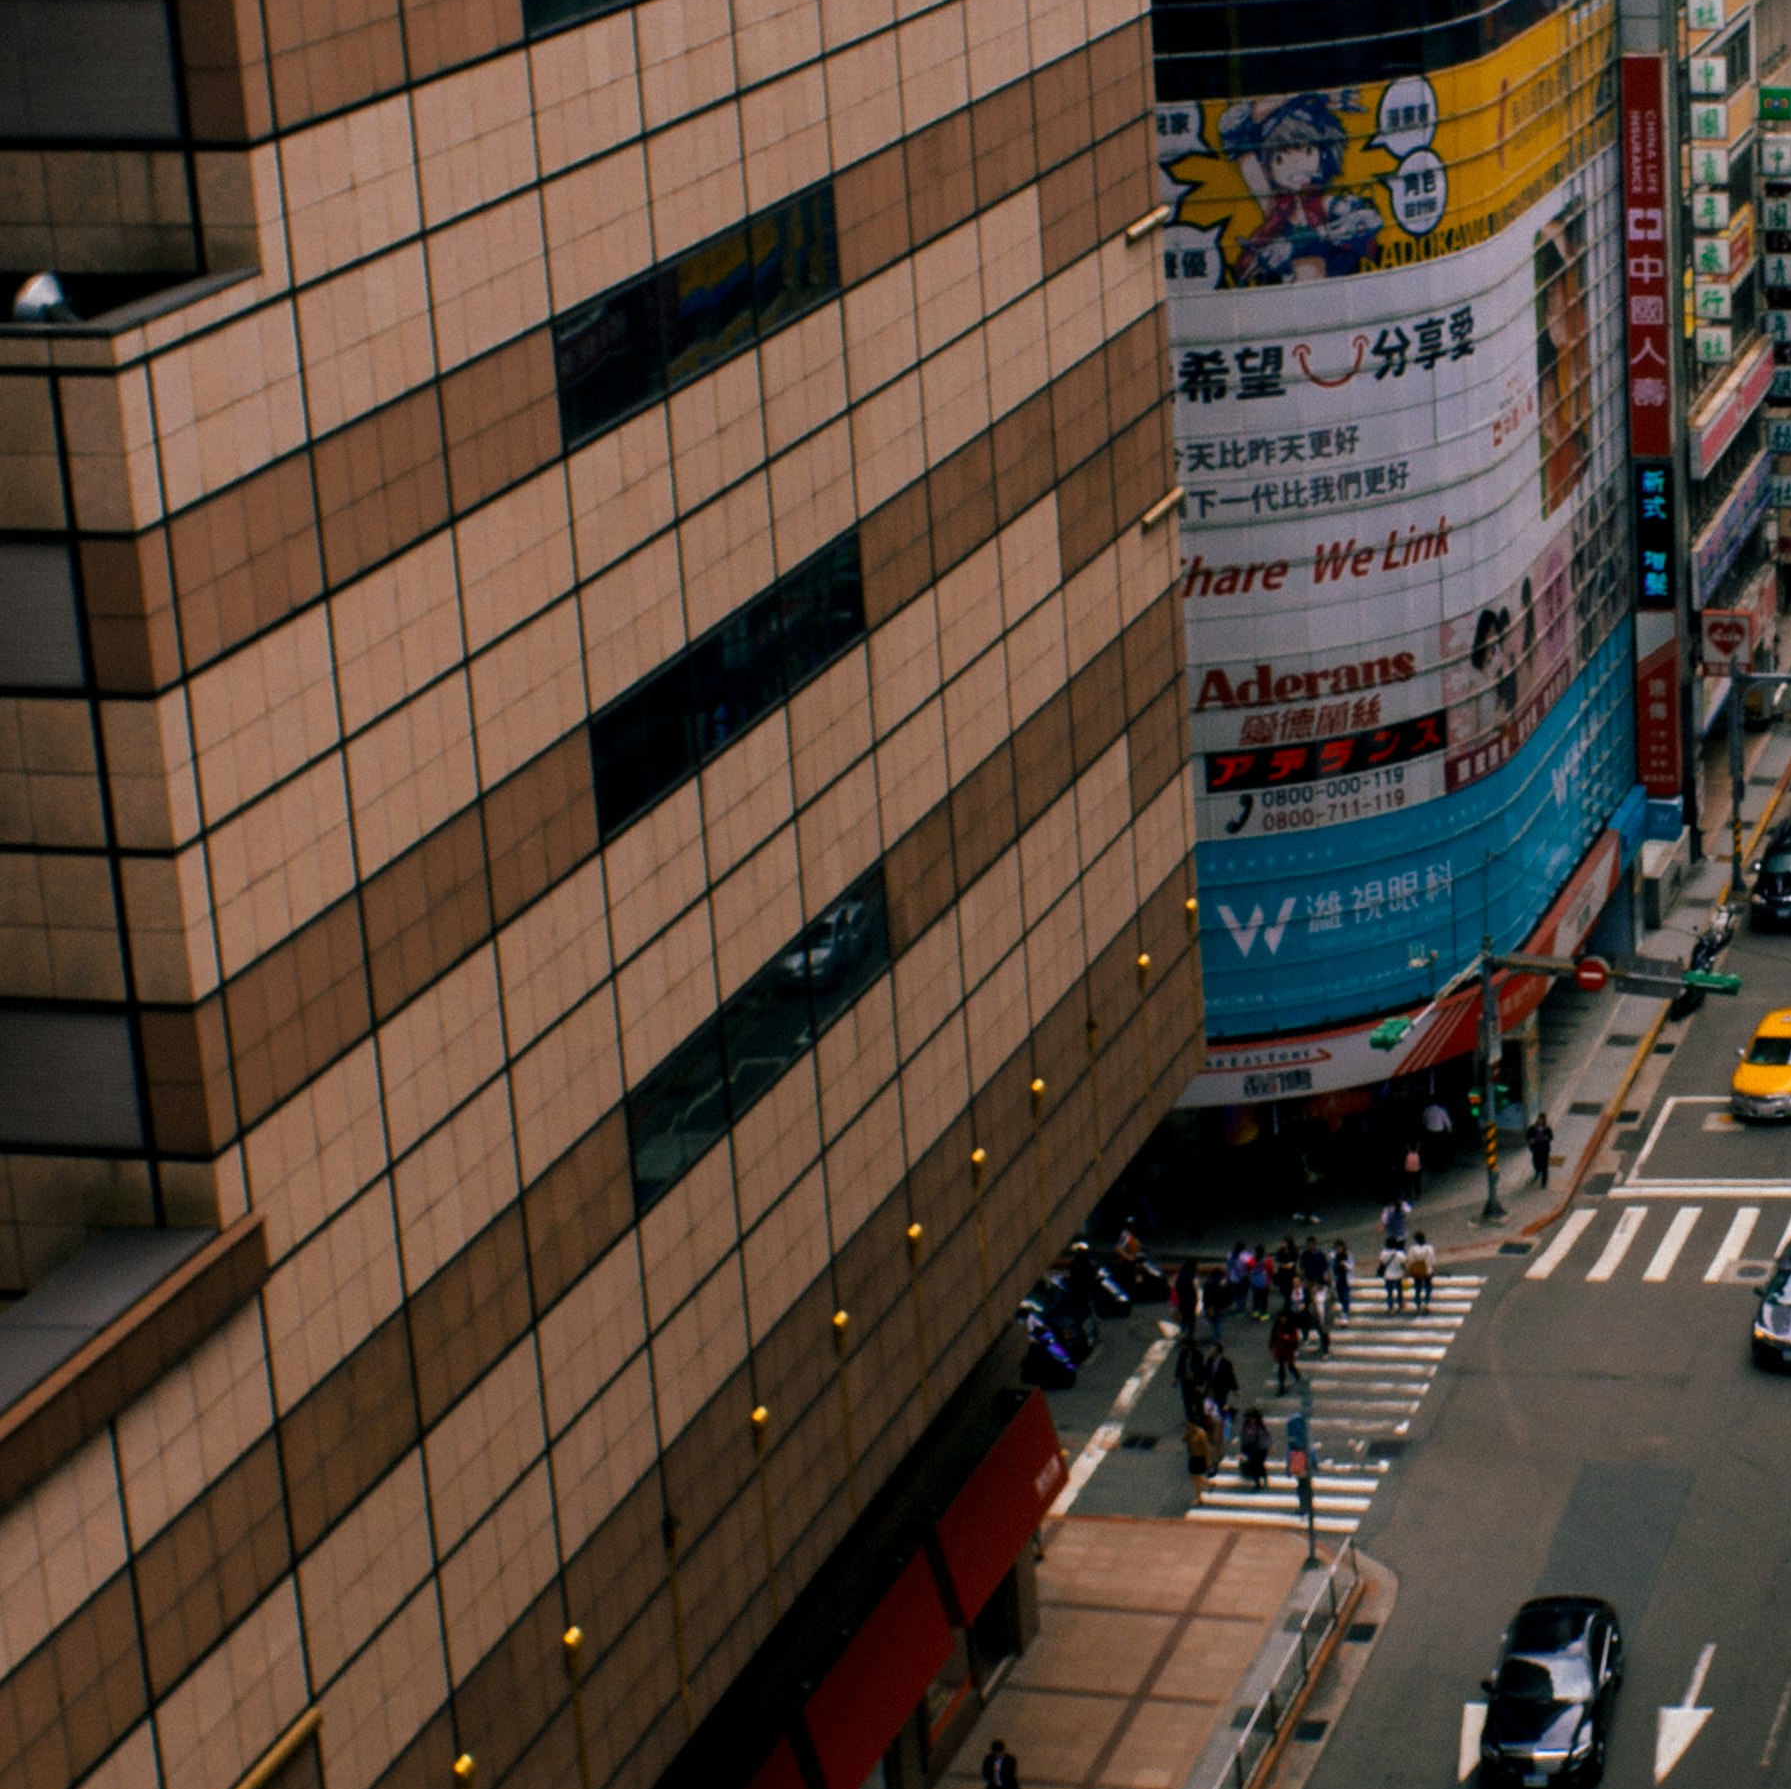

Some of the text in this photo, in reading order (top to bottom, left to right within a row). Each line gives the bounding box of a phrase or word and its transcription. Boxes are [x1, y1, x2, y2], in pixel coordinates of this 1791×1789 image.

[1178, 305, 1475, 404] 希望 分享愛
[1630, 254, 1666, 406] 中國人壽
[1312, 539, 1375, 585] We
[1382, 515, 1453, 572] Link
[1197, 650, 1417, 712] Aderans
[1210, 716, 1443, 788] アデランス
[1261, 767, 1405, 809] 0800-000-119
[1262, 788, 1405, 832] 0800-711-119
